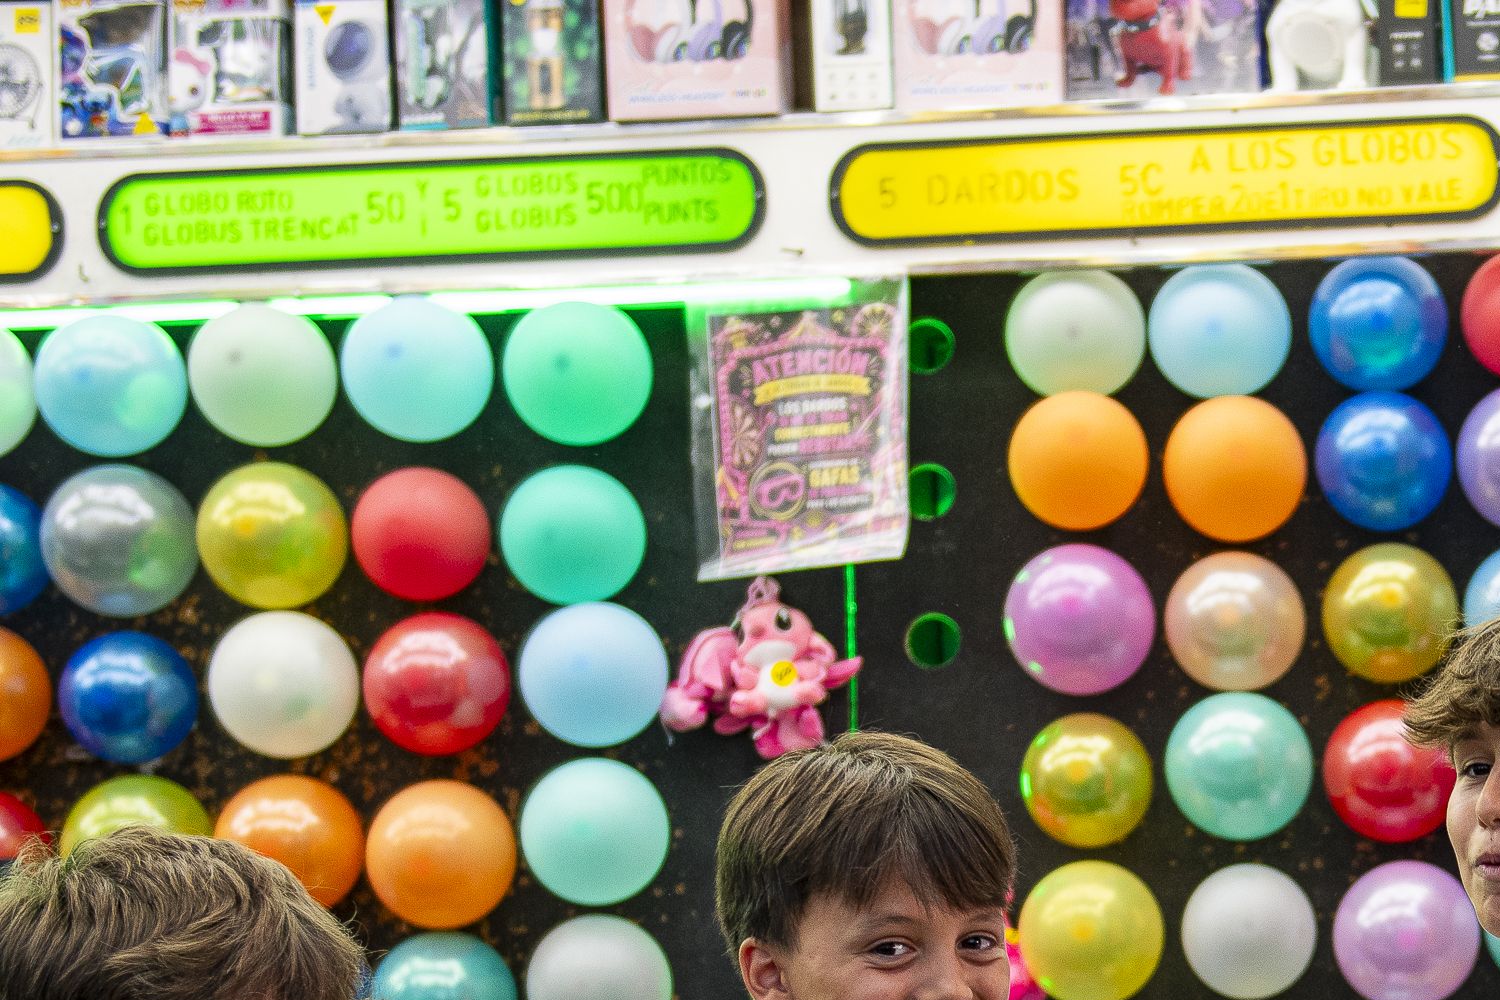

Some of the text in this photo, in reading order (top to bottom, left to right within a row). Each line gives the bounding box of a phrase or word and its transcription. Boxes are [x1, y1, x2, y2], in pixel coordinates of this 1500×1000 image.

[1189, 130, 1463, 174] A LOS GLOBOS
[474, 172, 579, 198] GLOBOS
[642, 161, 733, 188] PUNTOS
[879, 176, 897, 209] 5
[926, 167, 1079, 207] DARDOS
[144, 189, 293, 217] GLOBO ROTO
[1400, 178, 1463, 204] VALE
[120, 204, 132, 236] 1
[366, 190, 406, 226] 50
[443, 189, 462, 223] 5
[586, 181, 644, 215] 500
[475, 203, 578, 234] GLOBUS
[643, 197, 721, 225] PUNTS
[143, 213, 360, 246] GLOBUS TRENCAT
